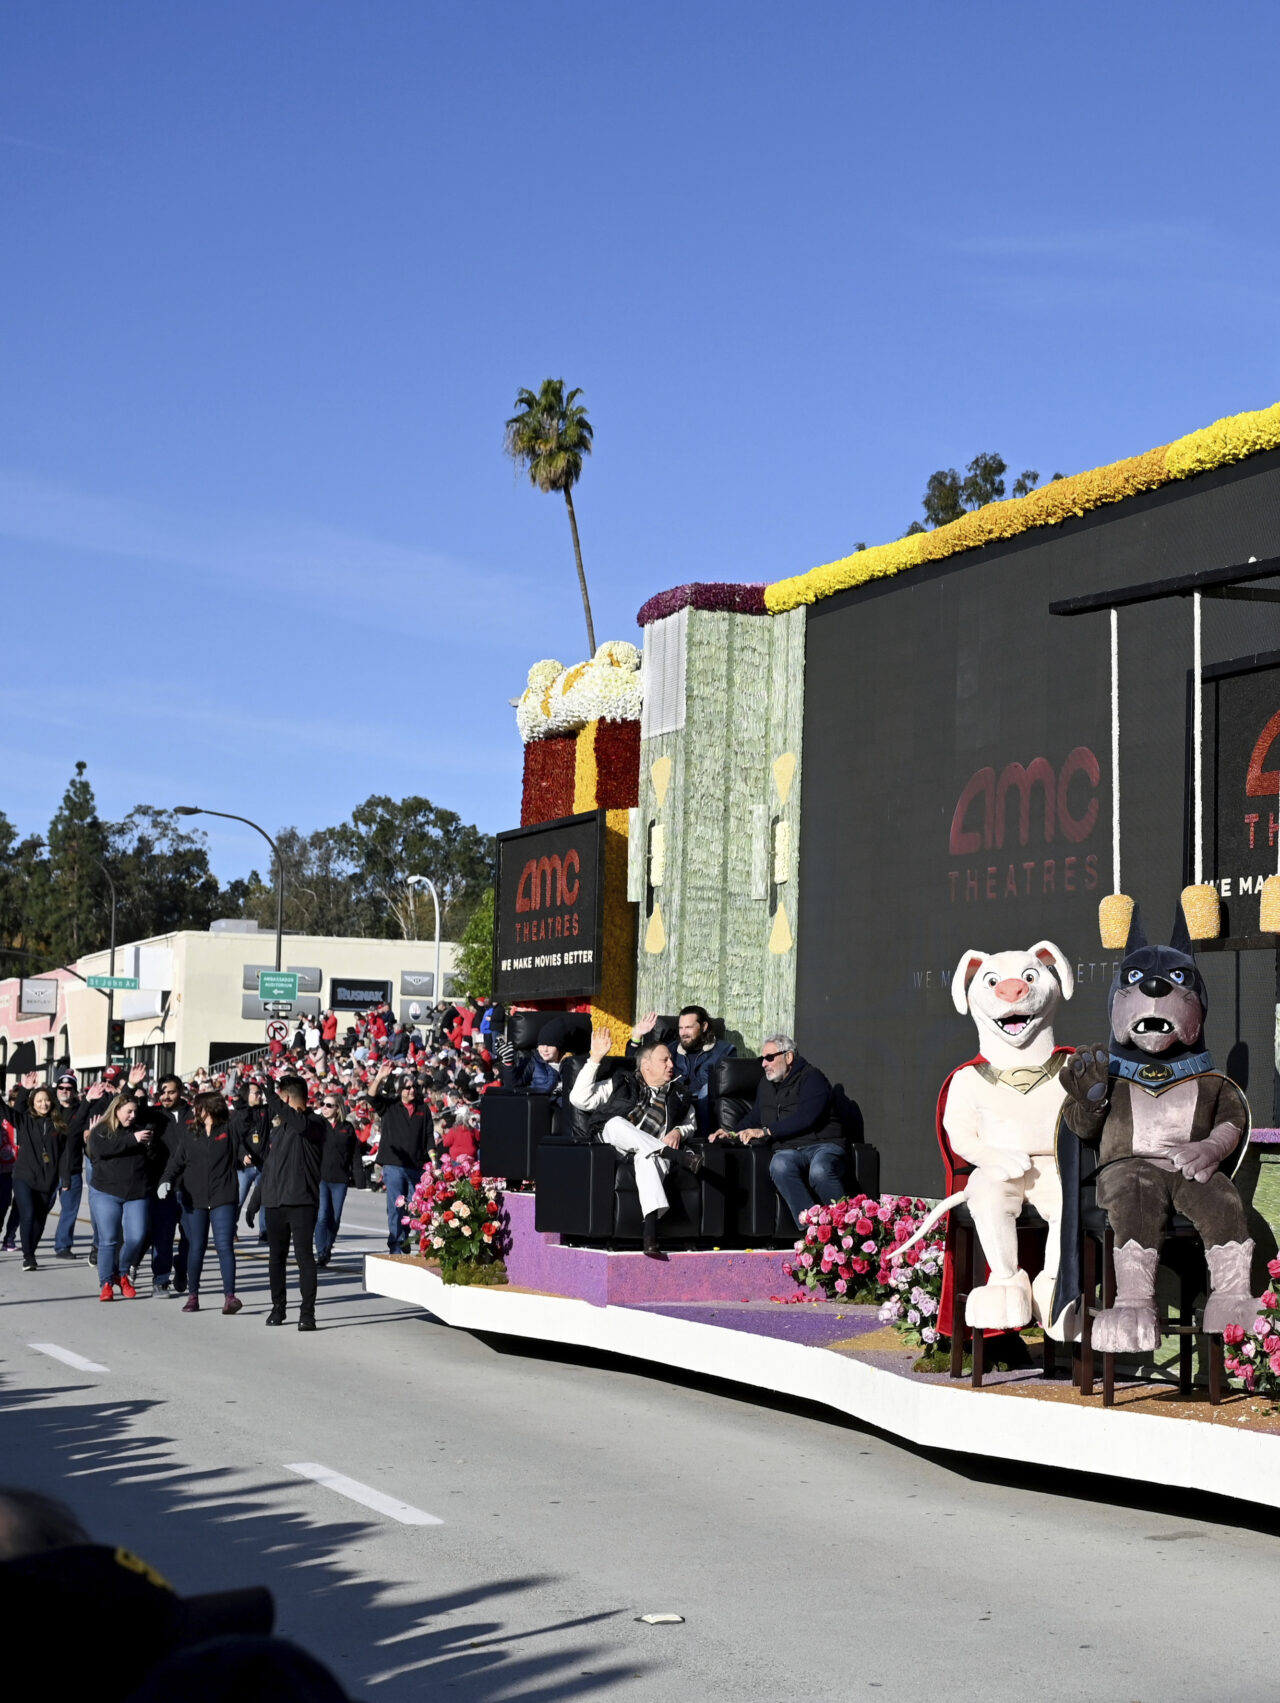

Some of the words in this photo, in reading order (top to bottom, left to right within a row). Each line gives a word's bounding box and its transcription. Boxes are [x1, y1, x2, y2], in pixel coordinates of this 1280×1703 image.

[948, 855, 1098, 902] THEATRES
[515, 912, 579, 944] THEATRES
[501, 959, 511, 971] WE
[513, 956, 532, 970] MAKE
[534, 953, 561, 968] MOVIES
[563, 950, 593, 965] BETTER
[336, 987, 384, 1002] RUSNAK
